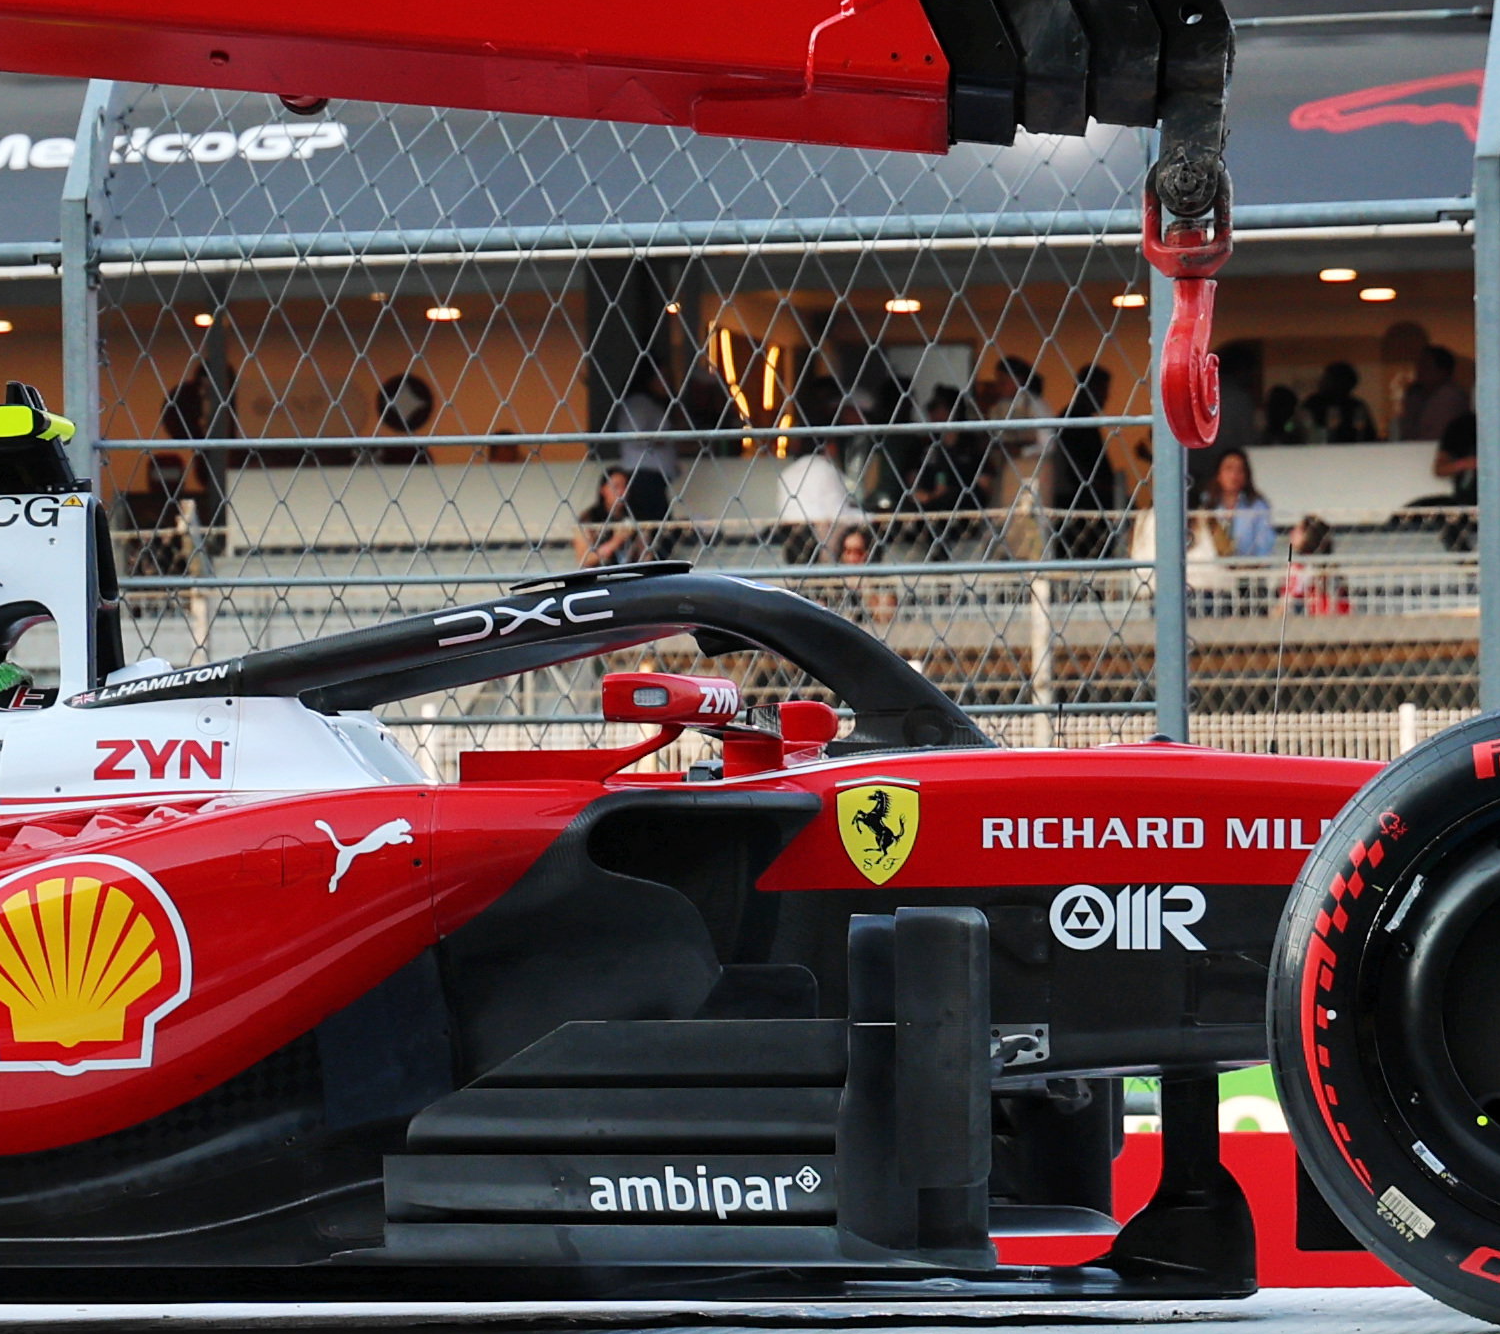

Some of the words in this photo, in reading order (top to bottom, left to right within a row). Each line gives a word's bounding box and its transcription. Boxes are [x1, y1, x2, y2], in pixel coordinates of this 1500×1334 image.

[433, 588, 614, 648] DXC
[98, 664, 230, 702] L.HAMILTON
[698, 686, 740, 716] ZYN
[93, 739, 224, 781] ZYN
[981, 816, 1206, 850] RICHARD
[588, 1164, 794, 1220] ambipar
